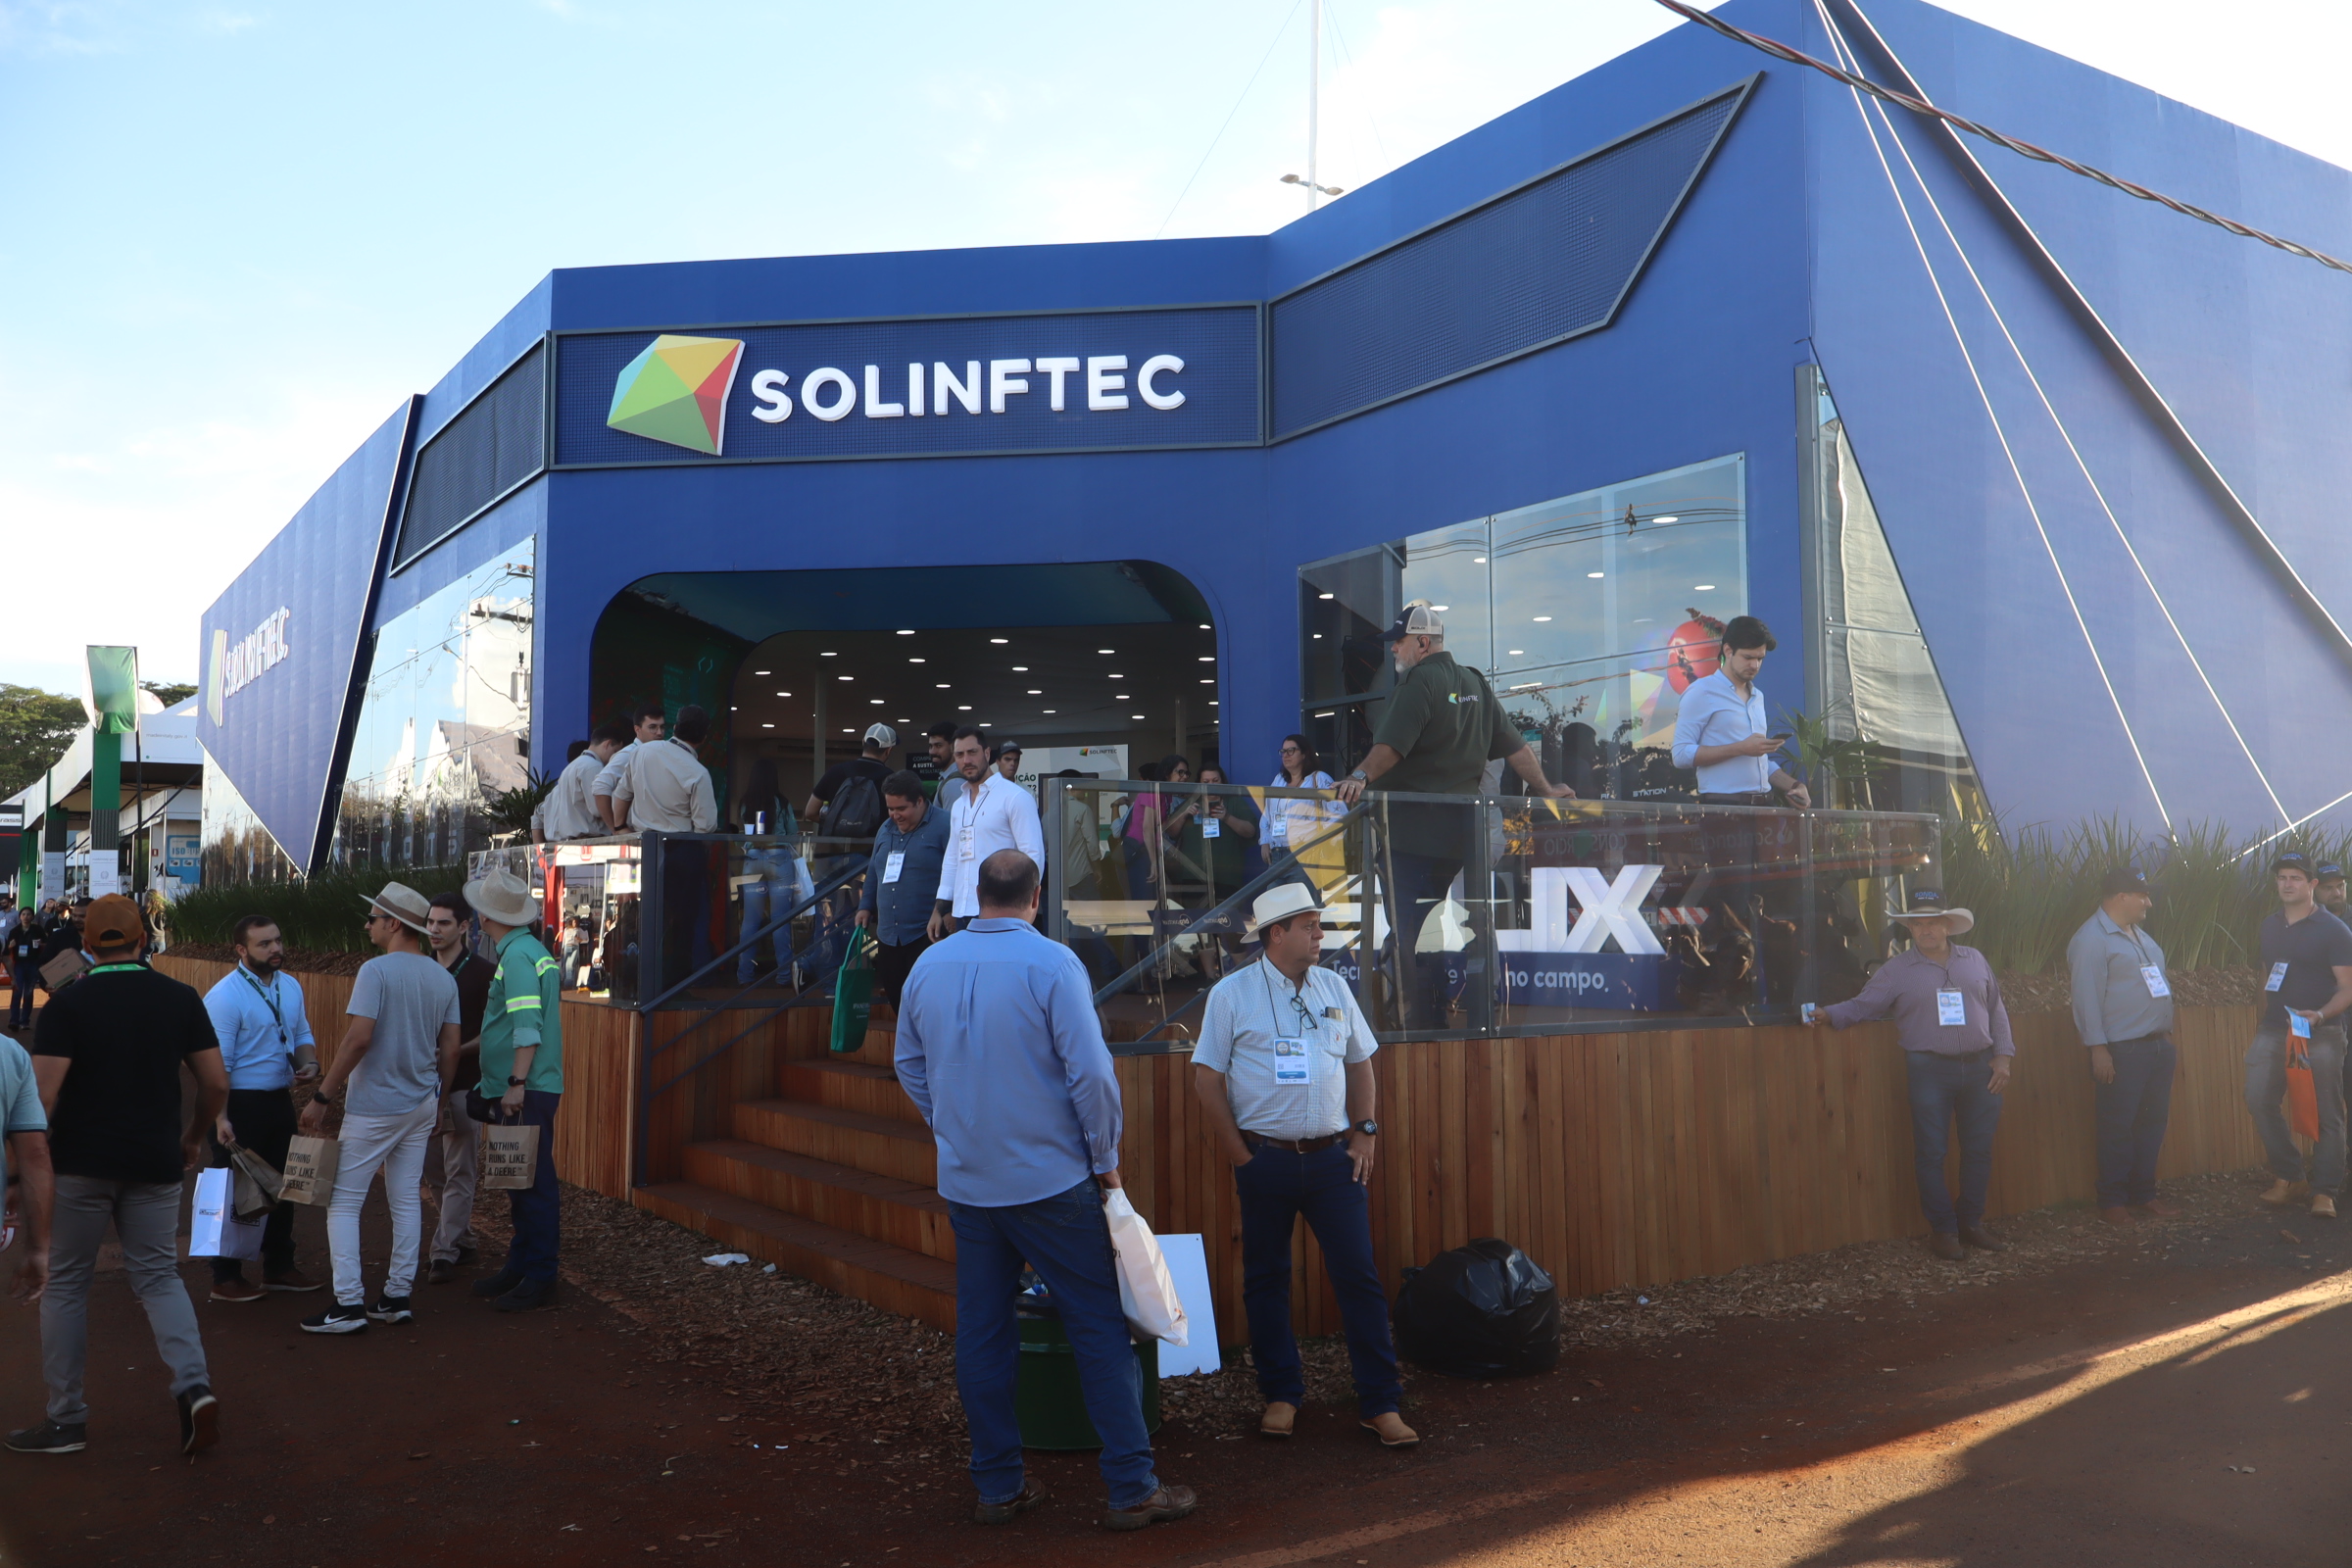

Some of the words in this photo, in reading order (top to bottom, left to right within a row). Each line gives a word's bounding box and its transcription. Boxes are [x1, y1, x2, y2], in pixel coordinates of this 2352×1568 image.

[751, 354, 1187, 424] SOLINFTEC
[1534, 971, 1609, 996] campo.
[488, 1142, 519, 1151] NOTHING
[488, 1154, 506, 1163] RUNS
[509, 1154, 525, 1163] LIKE
[298, 1167, 315, 1179] LIKE
[487, 1167, 493, 1176] A
